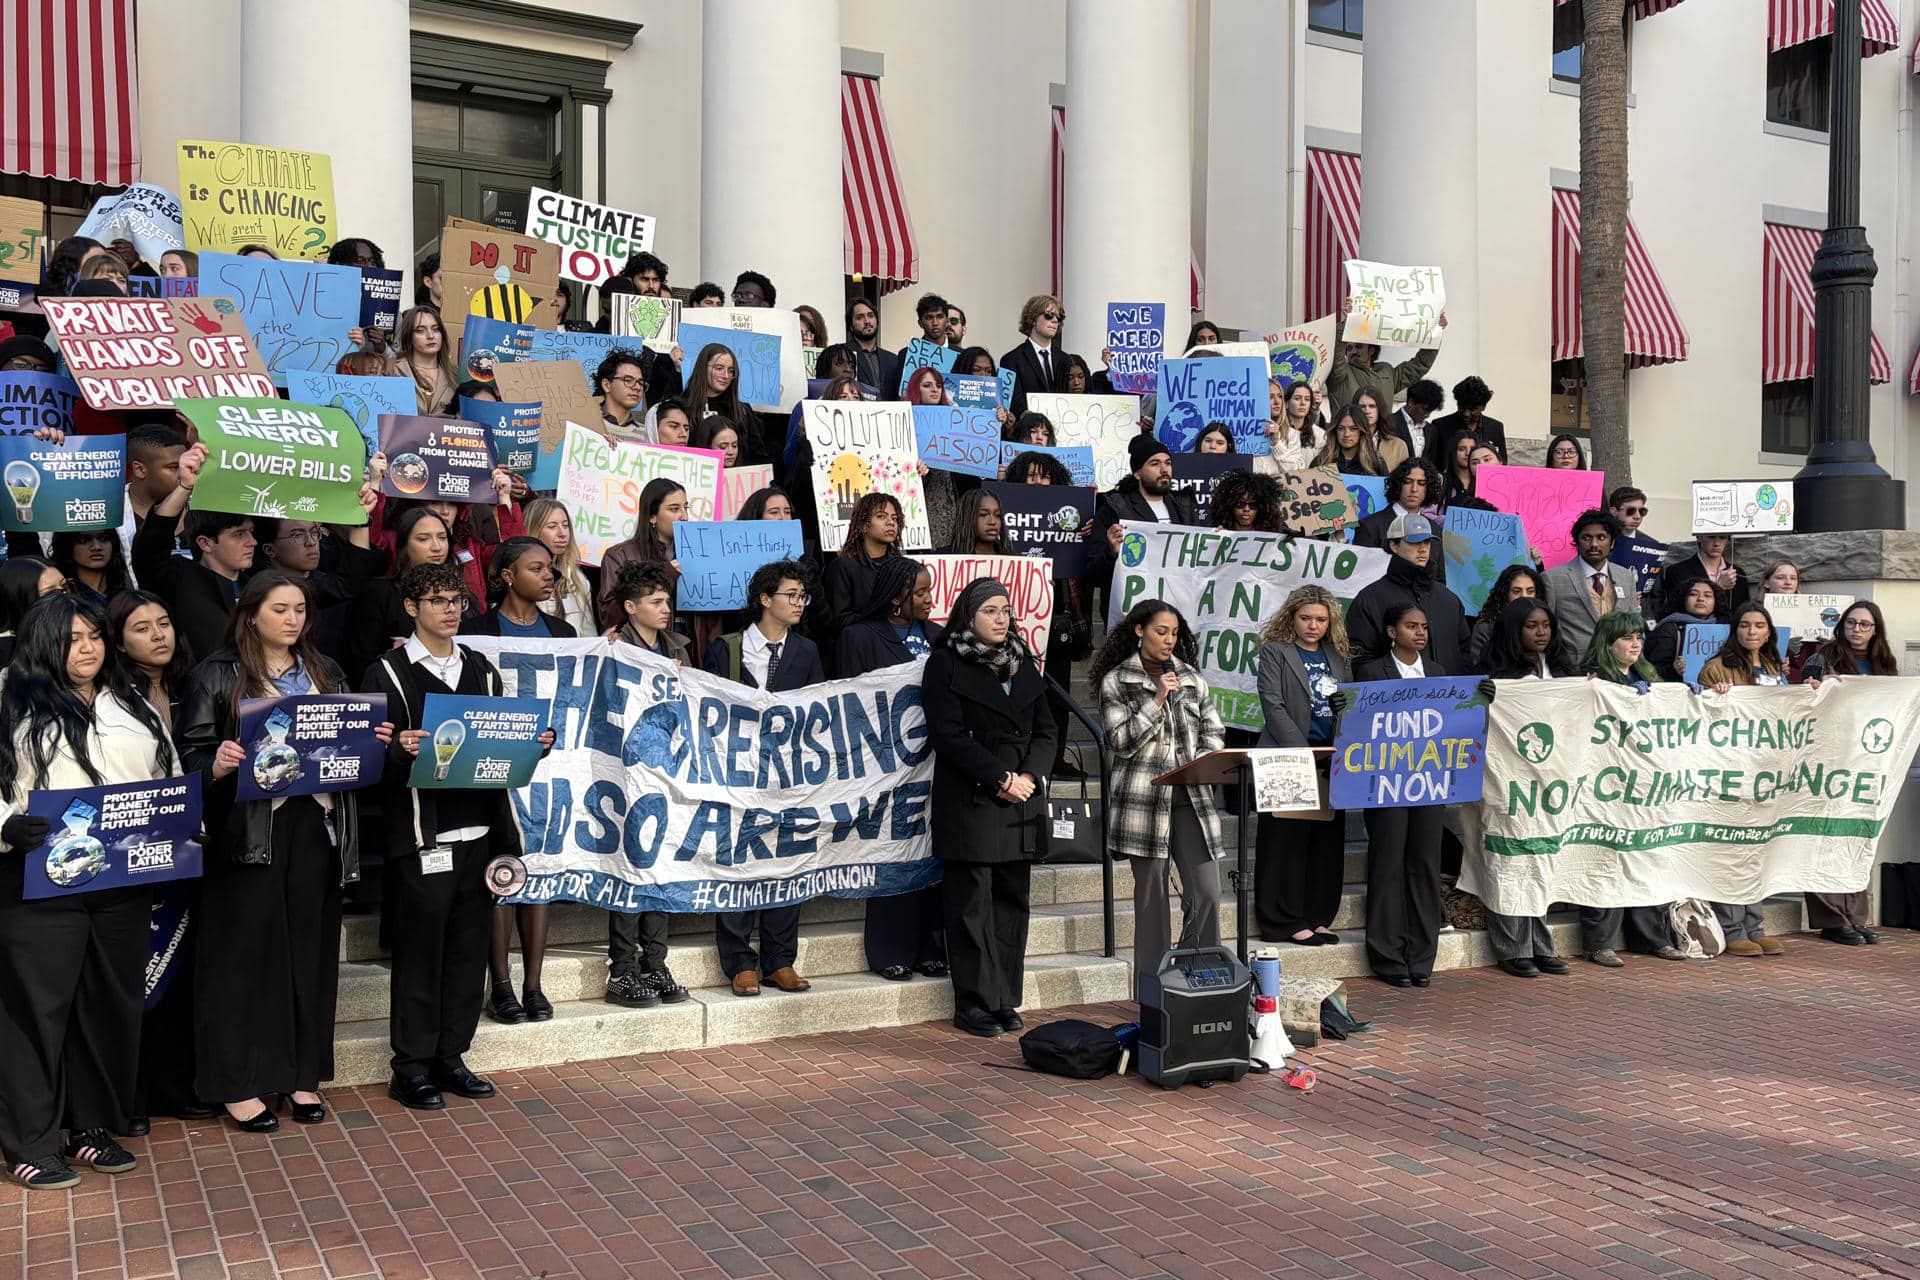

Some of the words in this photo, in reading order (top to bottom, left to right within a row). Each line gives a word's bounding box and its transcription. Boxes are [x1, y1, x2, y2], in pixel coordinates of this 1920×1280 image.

[182, 145, 216, 160] The
[215, 145, 316, 190] CLIMATE
[189, 184, 209, 201] is
[219, 189, 326, 225] CHANGING
[232, 218, 264, 236] aren't
[537, 195, 646, 241] CLIMATE
[533, 217, 642, 259] JUSTICE
[470, 240, 499, 268] DO
[513, 244, 537, 274] IT
[1352, 263, 1440, 296] Inve$t
[219, 263, 344, 320] SAVE
[40, 299, 179, 336] PRIVATE
[1113, 306, 1153, 325] WE
[1396, 298, 1435, 319] In
[261, 319, 297, 337] the
[1376, 314, 1433, 345] Earth
[1108, 329, 1162, 349] NEED
[1263, 333, 1279, 345] NO
[1284, 330, 1319, 346] PLACE
[60, 336, 183, 371] HANDS
[188, 335, 251, 369] OFF
[494, 345, 516, 355] FROM
[908, 337, 944, 364] SEA
[959, 379, 984, 387] PROTECT
[1164, 362, 1202, 402] WE
[1205, 367, 1251, 399] need
[79, 375, 194, 409] PUBLIC
[959, 389, 984, 397] PROTECT
[217, 405, 324, 428] CLEAN
[1208, 399, 1256, 418] HUMAN
[0, 406, 76, 434] CTION
[814, 404, 912, 452] SOLUTION
[216, 420, 339, 448] ENERGY
[443, 424, 485, 437] PROTECT
[441, 436, 487, 449] FLORIDA
[30, 451, 73, 461] CLEAN
[75, 450, 121, 461] ENERGY
[418, 447, 446, 457] FROM
[447, 450, 489, 461] CLIMATE
[507, 453, 533, 462] PODER
[567, 429, 679, 481] REGULATE
[678, 453, 715, 489] THE
[42, 461, 93, 471] STARTS
[94, 459, 121, 470] WITH
[220, 449, 296, 477] LOWER
[299, 459, 352, 483] BILLS
[448, 459, 489, 469] CHANGE
[507, 459, 532, 468] LATINX
[55, 469, 121, 481] EFFICIENCY
[438, 475, 470, 487] PODER
[438, 484, 470, 494] LATINX
[1306, 478, 1333, 497] do
[65, 502, 106, 513] PODER
[66, 511, 107, 521] LATINX
[1003, 512, 1043, 528] GHT
[1451, 510, 1511, 532] HANDS
[680, 524, 710, 559] AI
[719, 528, 753, 558] Isn't
[757, 531, 792, 560] thirsty
[822, 520, 846, 550] NOT
[1023, 530, 1084, 543] FUTURE
[1482, 533, 1516, 546] OUR
[1156, 531, 1249, 569] THERE
[1242, 536, 1297, 572] IS
[1301, 543, 1359, 580] NO
[680, 572, 722, 600] WE
[1771, 595, 1800, 608] MAKE
[1808, 594, 1838, 607] EARTH
[1201, 628, 1258, 676] FOR
[1359, 686, 1390, 713] for
[1392, 687, 1423, 703] our
[1426, 684, 1469, 700] sake
[296, 703, 346, 713] PROTECT
[347, 703, 371, 712] OUR
[296, 712, 340, 722] PLANET,
[463, 711, 498, 720] CLEAN
[498, 712, 540, 722] ENERGY
[296, 721, 345, 731] PROTECT
[346, 720, 370, 729] OUR
[470, 720, 511, 730] STARTS
[511, 722, 538, 731] WITH
[499, 651, 643, 759] THE
[756, 684, 930, 790] RISING
[1371, 708, 1444, 740] FUND
[295, 730, 338, 740] FUTURE
[476, 730, 537, 740] EFFICIENCY
[1590, 713, 1702, 754] SYSTEM
[1707, 717, 1818, 751] CHANGE
[320, 758, 361, 770] PODER
[1344, 738, 1474, 773] CLIMATE
[320, 768, 359, 779] LATINX
[473, 770, 509, 779] LATINX
[477, 761, 512, 771] PODER
[103, 789, 161, 804] PROTECT
[161, 785, 187, 797] OUR
[1508, 774, 1588, 817] NOT
[1594, 765, 1745, 807] CLIMATE
[101, 806, 159, 821] PROTECT
[160, 804, 186, 815] OUR
[102, 799, 153, 813] PLANET,
[100, 817, 150, 831] FUTURE
[574, 780, 669, 869] SO
[673, 799, 821, 867] ARE
[830, 780, 932, 843] WE
[1643, 829, 1666, 845] FOR
[1666, 825, 1684, 839] ALL
[128, 844, 173, 858] PODER
[128, 853, 174, 869] LATINX
[596, 878, 639, 909] ALL
[1192, 1020, 1233, 1036] ION
